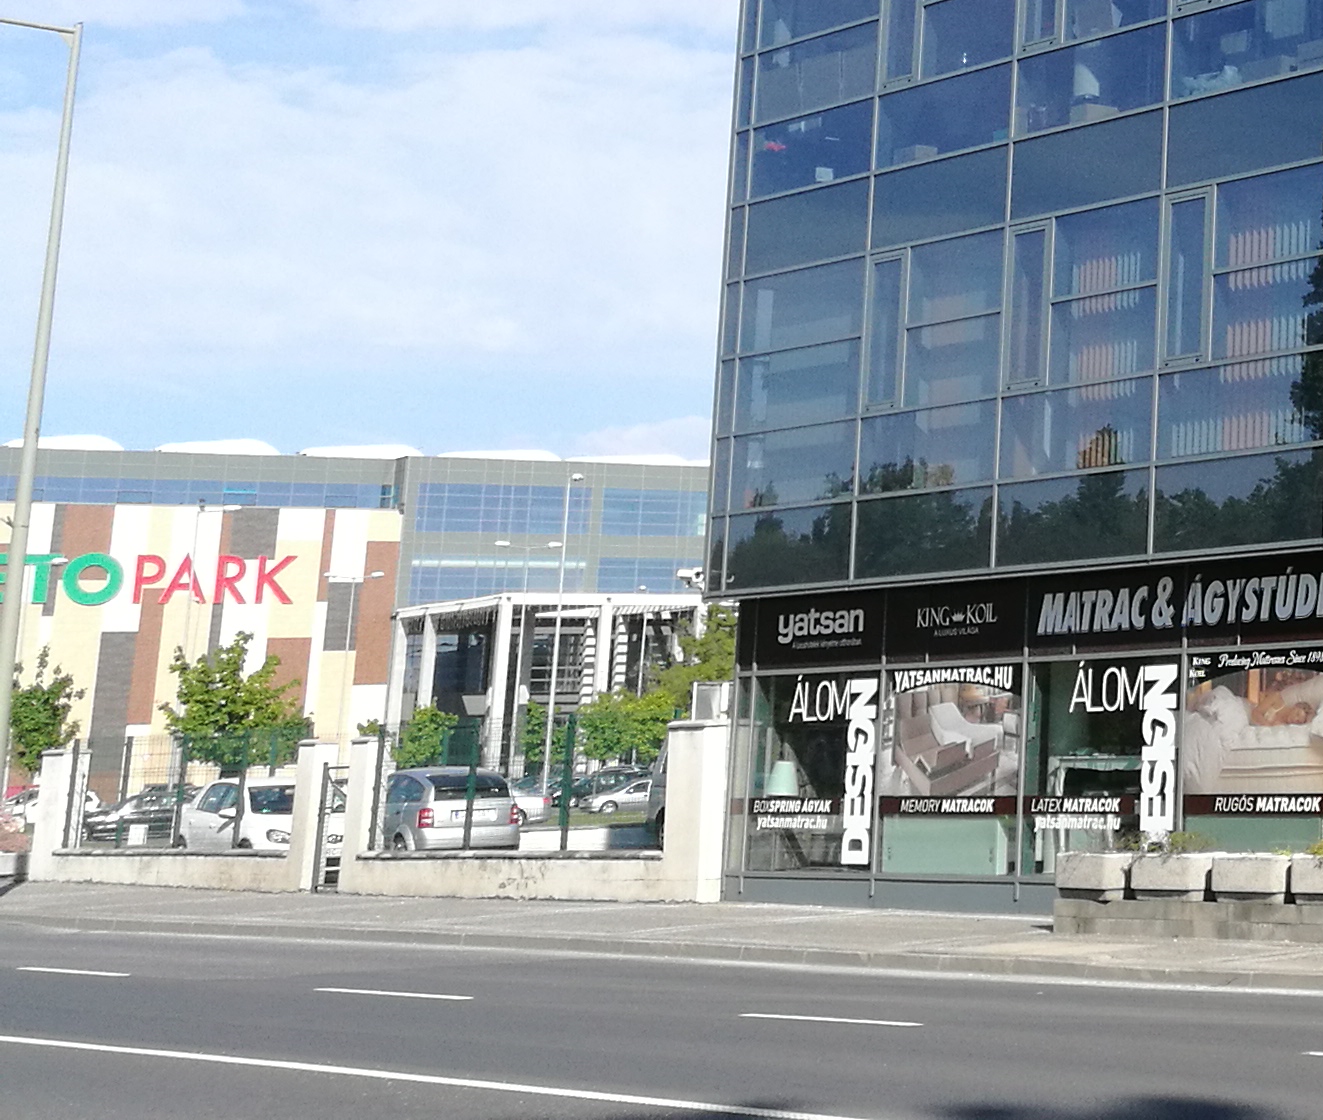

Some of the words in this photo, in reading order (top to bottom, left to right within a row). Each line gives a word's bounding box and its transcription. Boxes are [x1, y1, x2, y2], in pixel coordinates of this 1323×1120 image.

[132, 552, 298, 605] PARK
[916, 606, 950, 628] KING
[966, 603, 998, 625] KOIL
[1037, 586, 1149, 636] MATRAC
[1152, 576, 1176, 630] &
[777, 608, 864, 644] yatsan
[894, 666, 1013, 693] YATSANMATRAC.HU
[1069, 660, 1144, 713] ÁLOM
[788, 674, 850, 723] ÁLOM
[841, 678, 878, 865] DESIGN
[753, 798, 801, 813] BOXSPRING
[801, 797, 832, 813] ÁGYAK
[900, 799, 940, 814] MEMORY
[940, 798, 994, 813] MATRACOK
[1031, 797, 1062, 812] LATEX
[1062, 797, 1120, 812] MATRACOK
[1214, 795, 1254, 812] RUGÓS
[1255, 796, 1322, 812] MATRACOK
[757, 814, 828, 830] yatsanmatrac.hu
[1034, 814, 1120, 832] yatsanmatrac.hu
